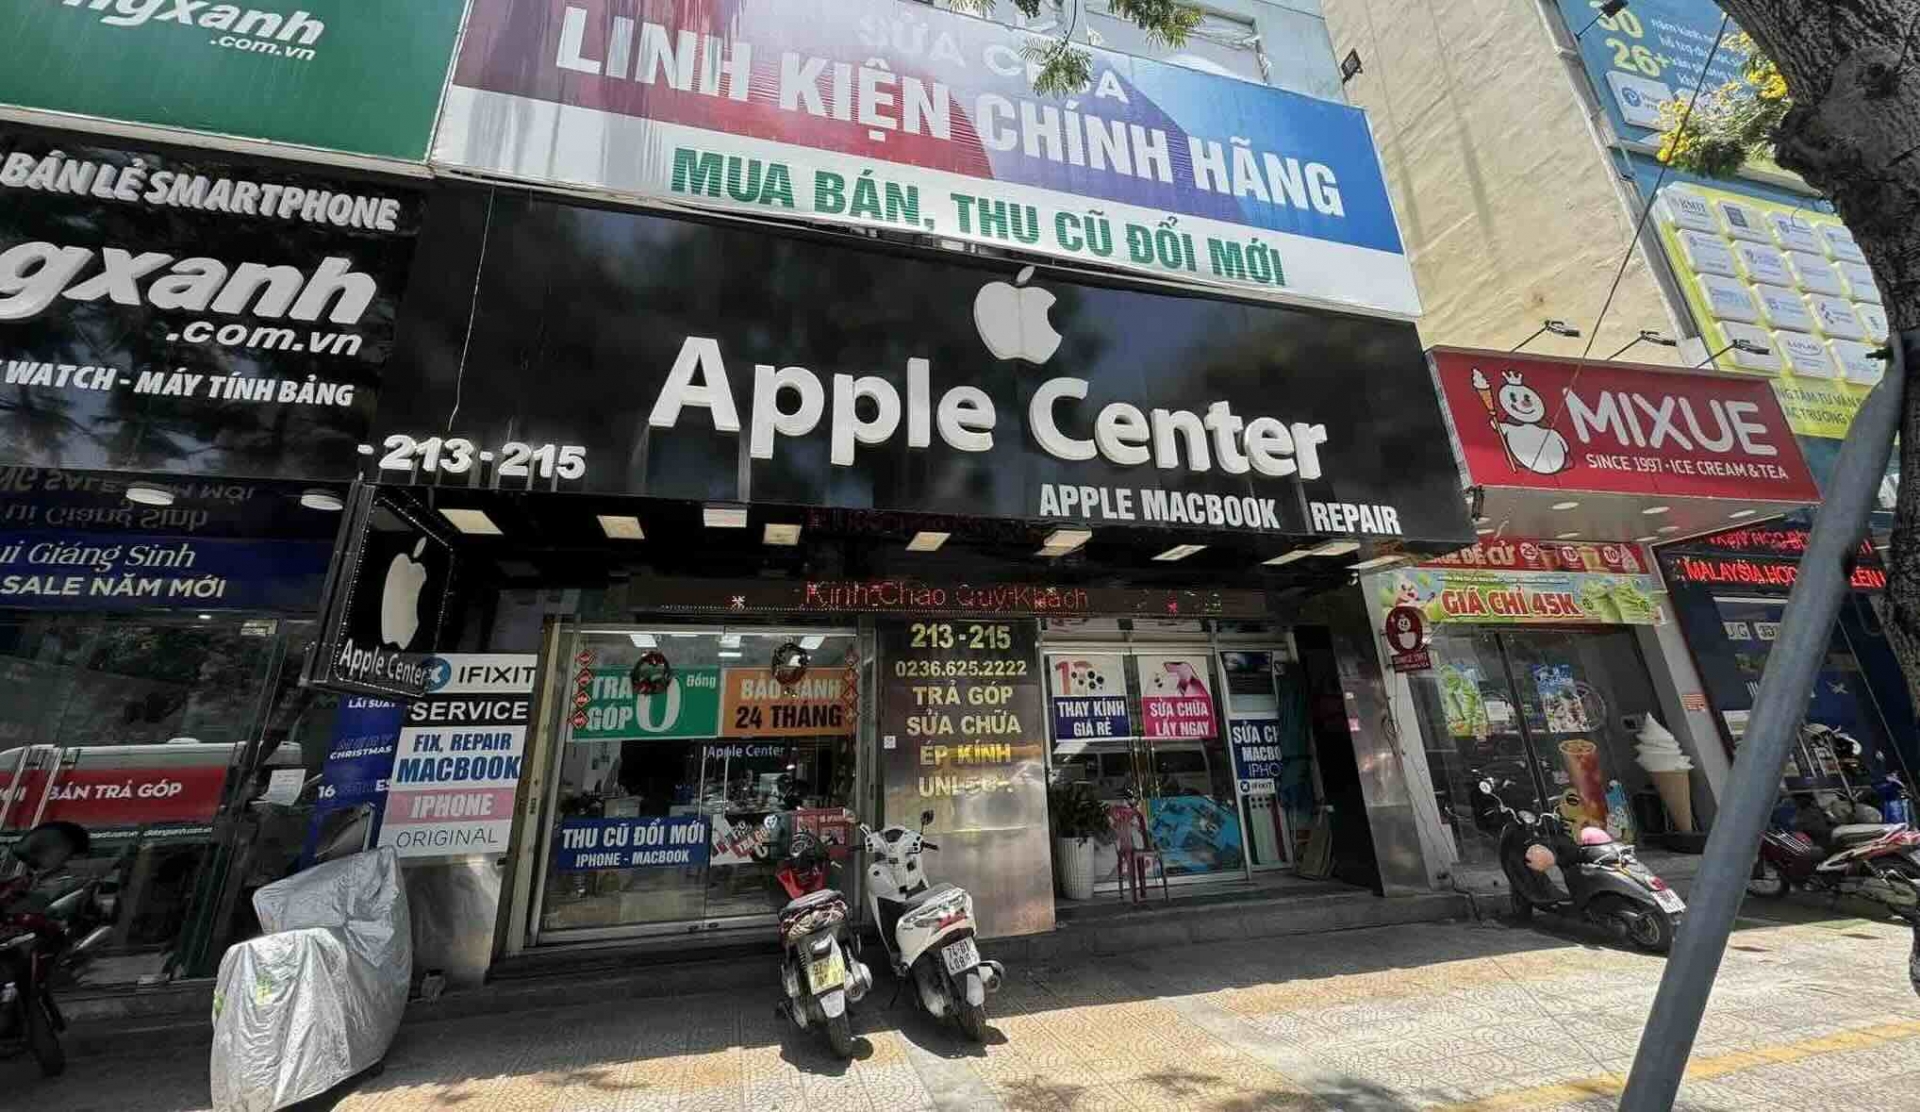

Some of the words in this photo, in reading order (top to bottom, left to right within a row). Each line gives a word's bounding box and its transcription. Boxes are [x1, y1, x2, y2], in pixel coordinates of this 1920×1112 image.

[210, 36, 316, 61] .com.vn
[556, 6, 752, 102] LINH
[779, 52, 952, 142] KIỆN
[974, 92, 1173, 184] CHÍNH
[1188, 136, 1344, 217] HÃNG
[2, 150, 100, 197] BÁN
[145, 170, 401, 233] SMARTPHONE
[671, 147, 795, 209] MUA
[813, 170, 936, 231] BÁN,
[950, 193, 1041, 246] THU
[1056, 211, 1113, 257] CŨ
[1125, 216, 1197, 272] ĐỔI
[1208, 237, 1286, 287] MỚI
[166, 320, 363, 356] .com.vn
[4, 359, 119, 393] WATCH
[134, 370, 201, 399] MÁY
[208, 371, 277, 403] TÍNH
[277, 375, 355, 407] BẢNG
[648, 335, 997, 467] Apple
[1028, 377, 1328, 481] Center
[1564, 386, 1779, 456] MIXUE
[1586, 453, 1632, 472] SINCE
[1633, 456, 1662, 473] 1997
[1670, 459, 1695, 475] ICE
[1039, 484, 1136, 521] APPLE
[1140, 489, 1281, 530] MACBOOK
[1310, 502, 1403, 536] REPAIR
[28, 540, 121, 573] Giáng
[125, 542, 197, 569] Sinh
[0, 575, 84, 597] SALE
[89, 573, 163, 597] NĂM
[167, 574, 228, 599] MỚI
[1440, 585, 1487, 618] GIÁ
[1486, 586, 1532, 618] CHỈ
[1530, 591, 1585, 619] 45K
[911, 623, 955, 649] 213
[969, 625, 1012, 650] 215
[338, 638, 384, 679] Apple
[386, 653, 426, 688] Center
[457, 666, 537, 684] IFIXIT
[895, 660, 1027, 677] 0236.625.2222
[592, 671, 634, 700] TRẢ
[741, 672, 783, 701] BẢO
[785, 673, 842, 701] ÀNH
[912, 679, 961, 706] TRẢ
[967, 681, 1014, 705] GÓP
[410, 701, 529, 721] SERVICE
[586, 702, 634, 732] GÓP
[735, 706, 763, 729] 24
[770, 700, 842, 729] THÁNG
[1057, 701, 1090, 718] THAY
[1093, 697, 1126, 717] KÍNH
[1149, 697, 1175, 718] SỬA
[907, 708, 955, 736] SỬA
[960, 709, 1023, 734] CHỮA
[1073, 718, 1094, 737] GIÁ
[1096, 716, 1112, 737] RẺ
[1180, 720, 1211, 737] NGAY
[1232, 722, 1261, 744] SỬA
[329, 744, 393, 761] CHRISTMAS
[413, 734, 444, 754] FIX,
[450, 732, 513, 751] REPAIR
[919, 741, 949, 766] ÉP
[956, 739, 1012, 764] KÍNH
[395, 755, 522, 784] MACBOOK
[94, 779, 133, 799] TRẢ
[137, 779, 183, 797] GÓP
[317, 785, 337, 799] 16
[409, 793, 495, 819] IPHONE
[395, 827, 499, 848] ORIGINAL
[562, 828, 600, 849] THU
[603, 822, 630, 848] CŨ
[632, 817, 665, 846] ĐỔI
[668, 820, 705, 845] MỚI
[575, 852, 621, 867] IPHONE
[631, 849, 690, 865] MACBOOK
